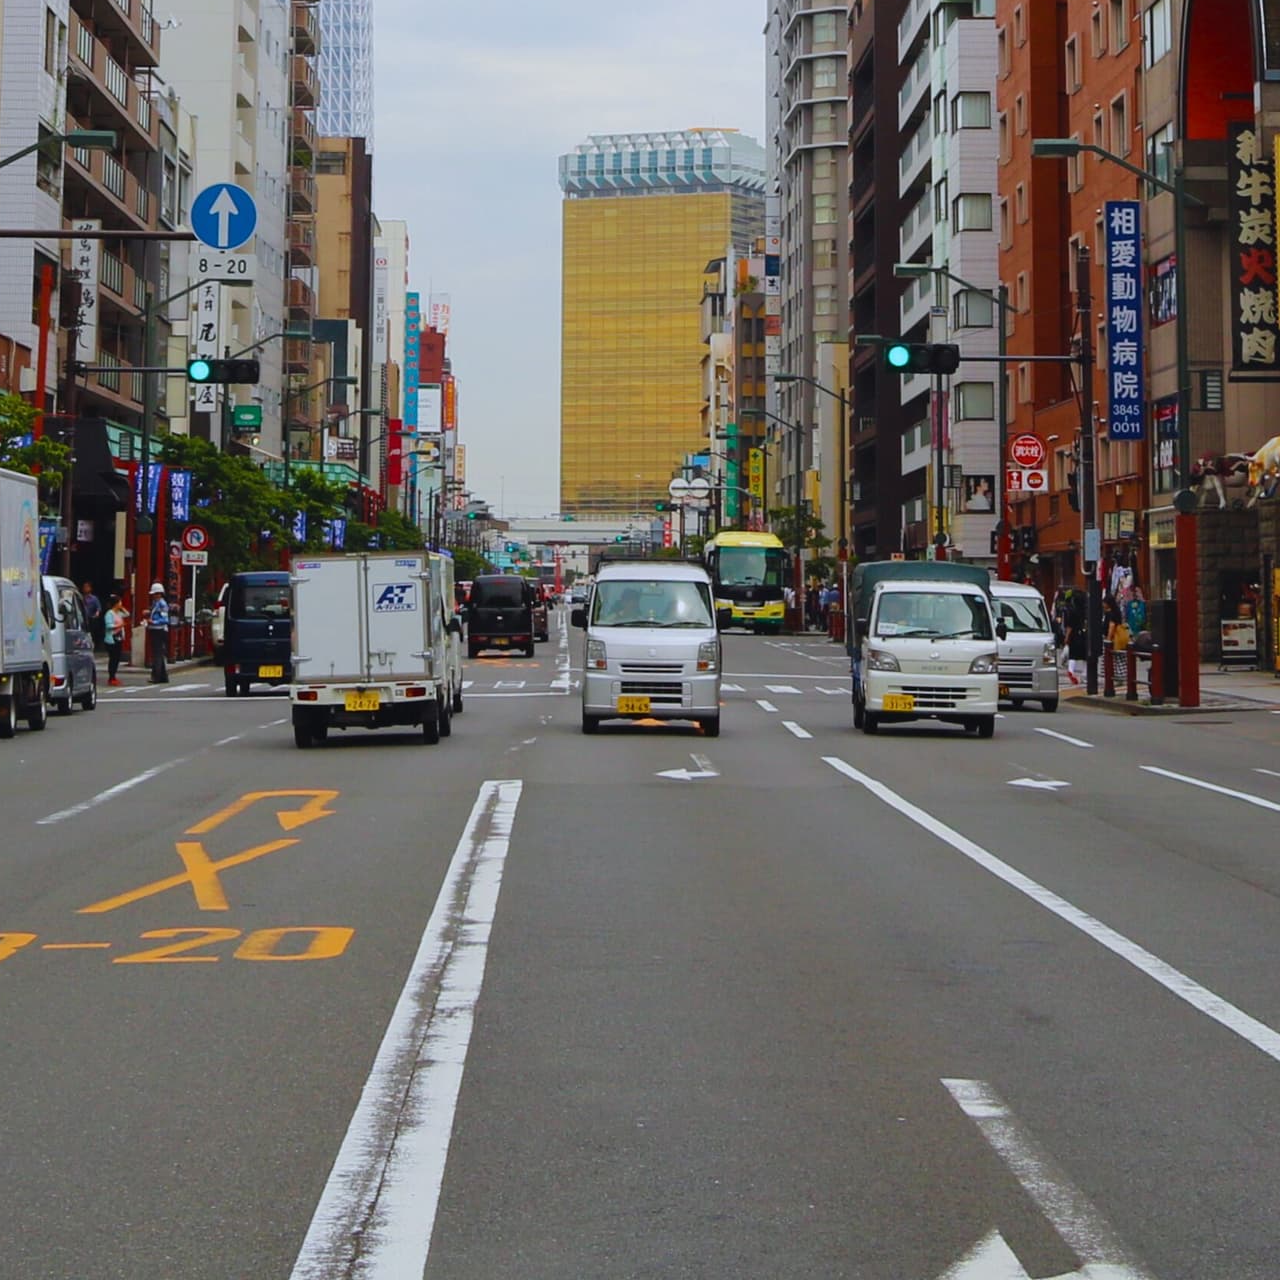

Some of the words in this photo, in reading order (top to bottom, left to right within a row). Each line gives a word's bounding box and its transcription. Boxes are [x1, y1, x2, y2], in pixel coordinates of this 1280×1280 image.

[199, 258, 247, 273] 8-20
[1111, 207, 1138, 399] 相愛動物病院
[197, 322, 216, 405] 尾屋
[1015, 445, 1040, 458] 消火栓
